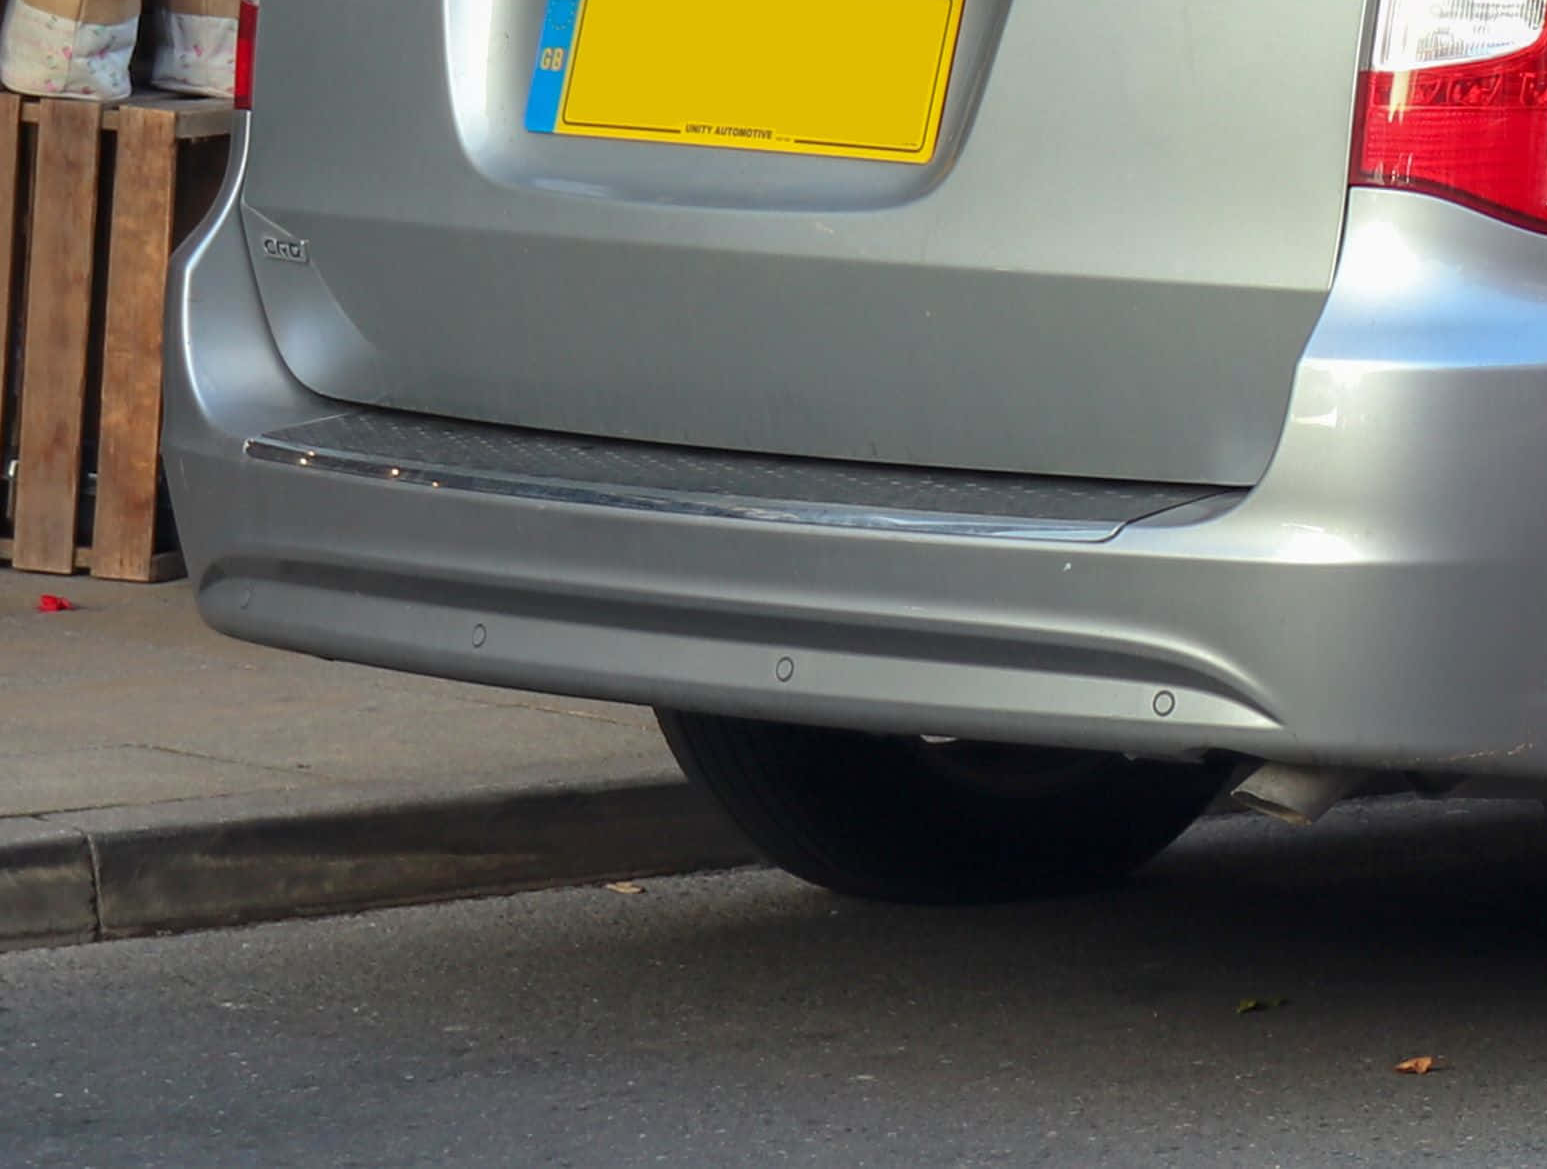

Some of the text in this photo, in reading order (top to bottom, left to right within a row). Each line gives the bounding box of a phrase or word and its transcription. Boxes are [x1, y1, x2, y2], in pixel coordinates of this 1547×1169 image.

[540, 47, 565, 72] GB
[685, 124, 713, 135] UNITY
[714, 126, 774, 140] AUTOMOTIVE
